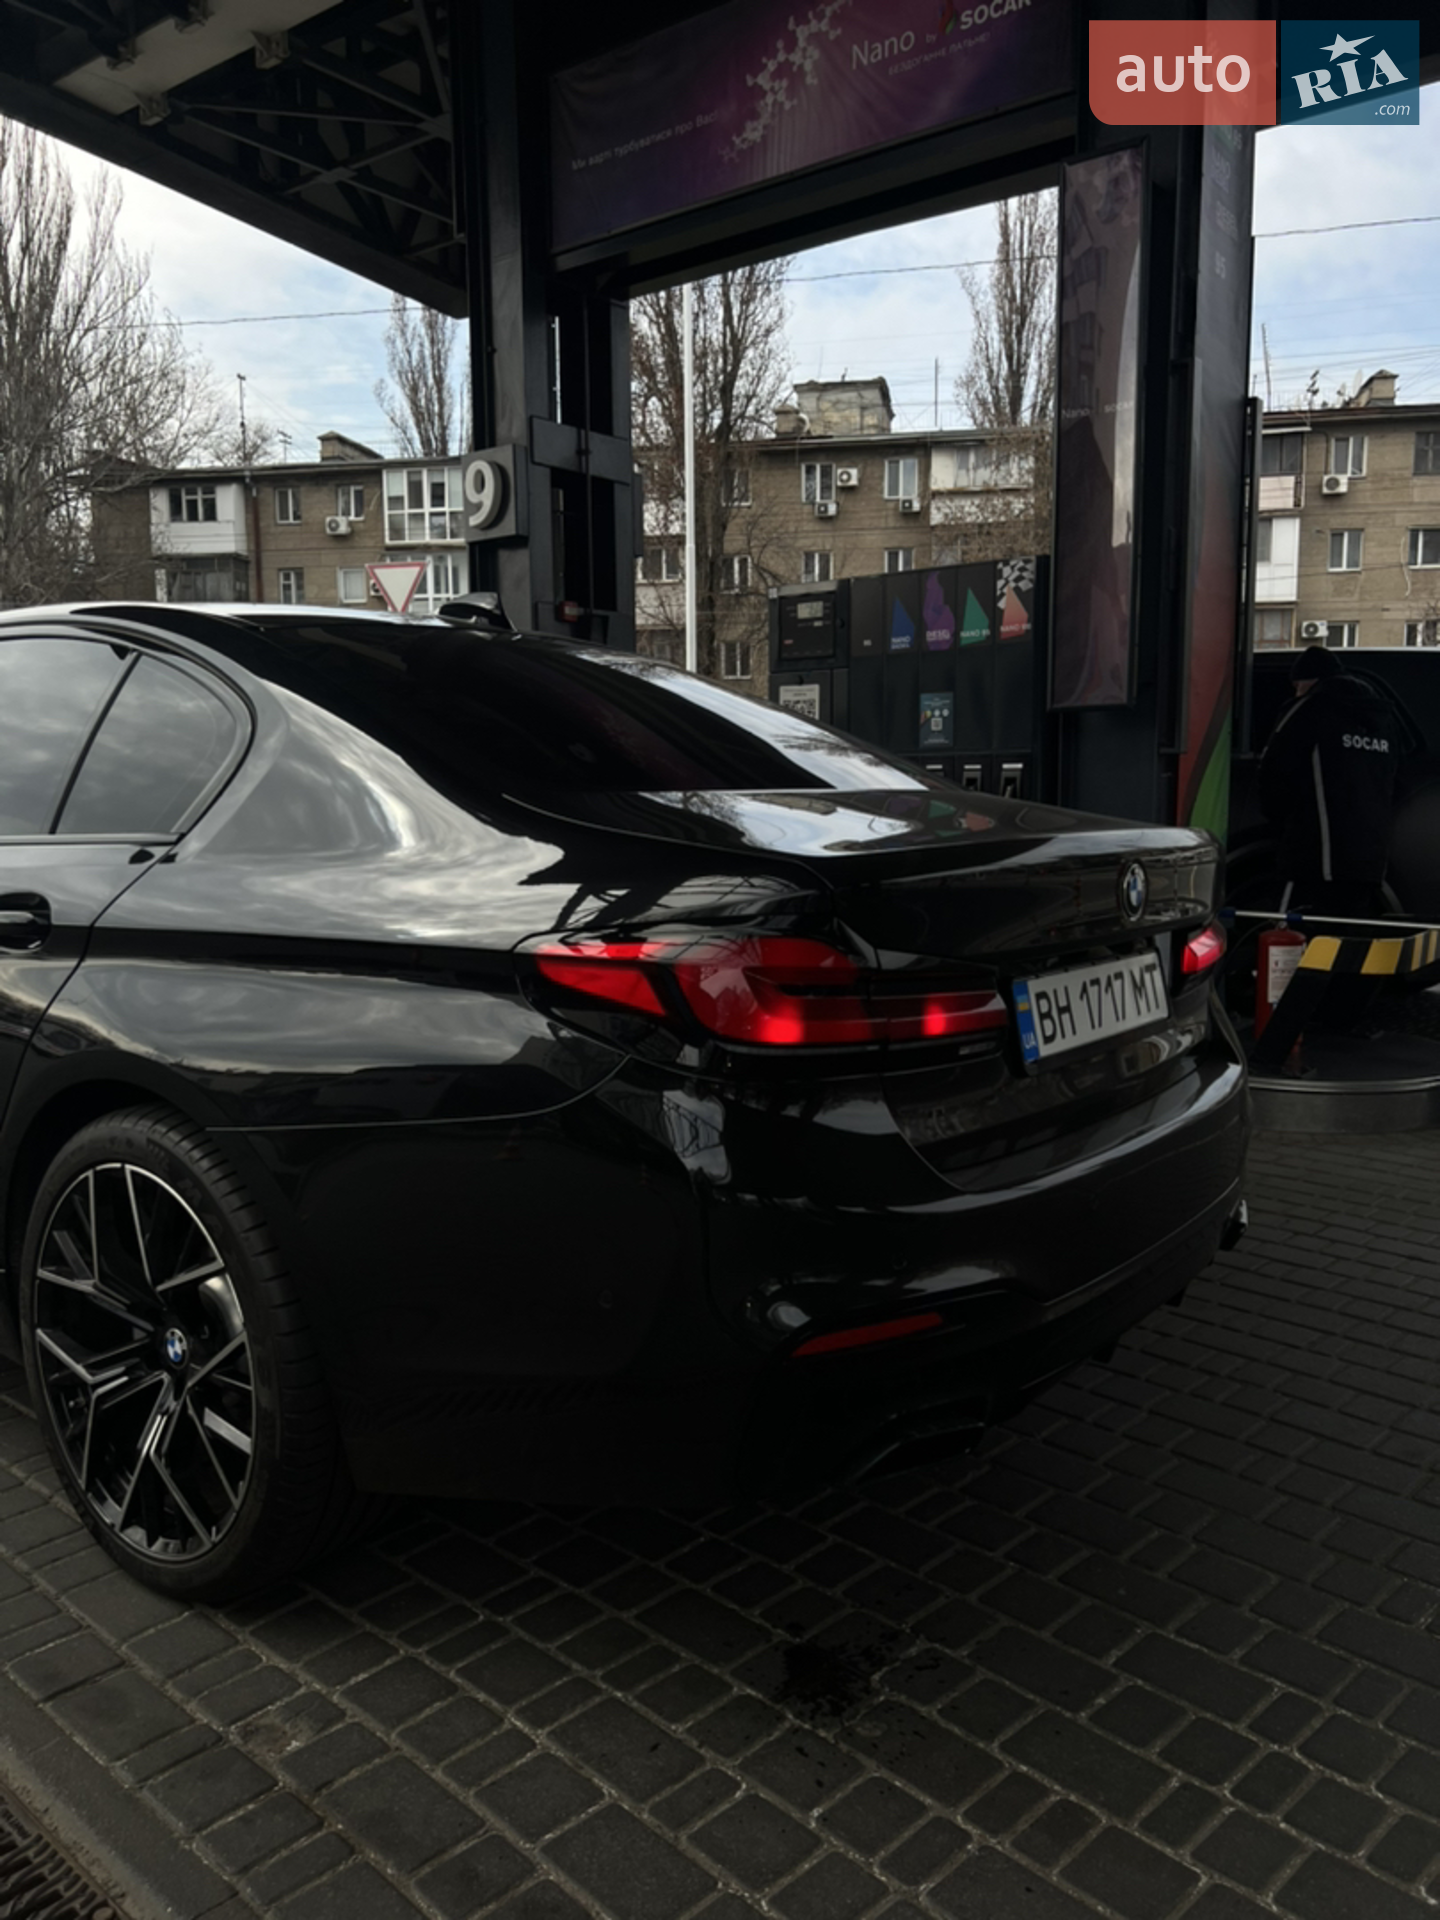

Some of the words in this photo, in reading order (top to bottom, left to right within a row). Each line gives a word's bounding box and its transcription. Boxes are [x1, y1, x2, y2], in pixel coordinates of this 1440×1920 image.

[851, 30, 916, 70] Nano
[925, 33, 938, 45] by
[674, 120, 694, 137] про
[465, 459, 501, 530] 9
[1341, 733, 1390, 754] SOCAR
[1035, 985, 1077, 1045] BH
[1079, 970, 1126, 1030] 1717
[1129, 963, 1160, 1016] MT
[1021, 1031, 1039, 1050] UA
